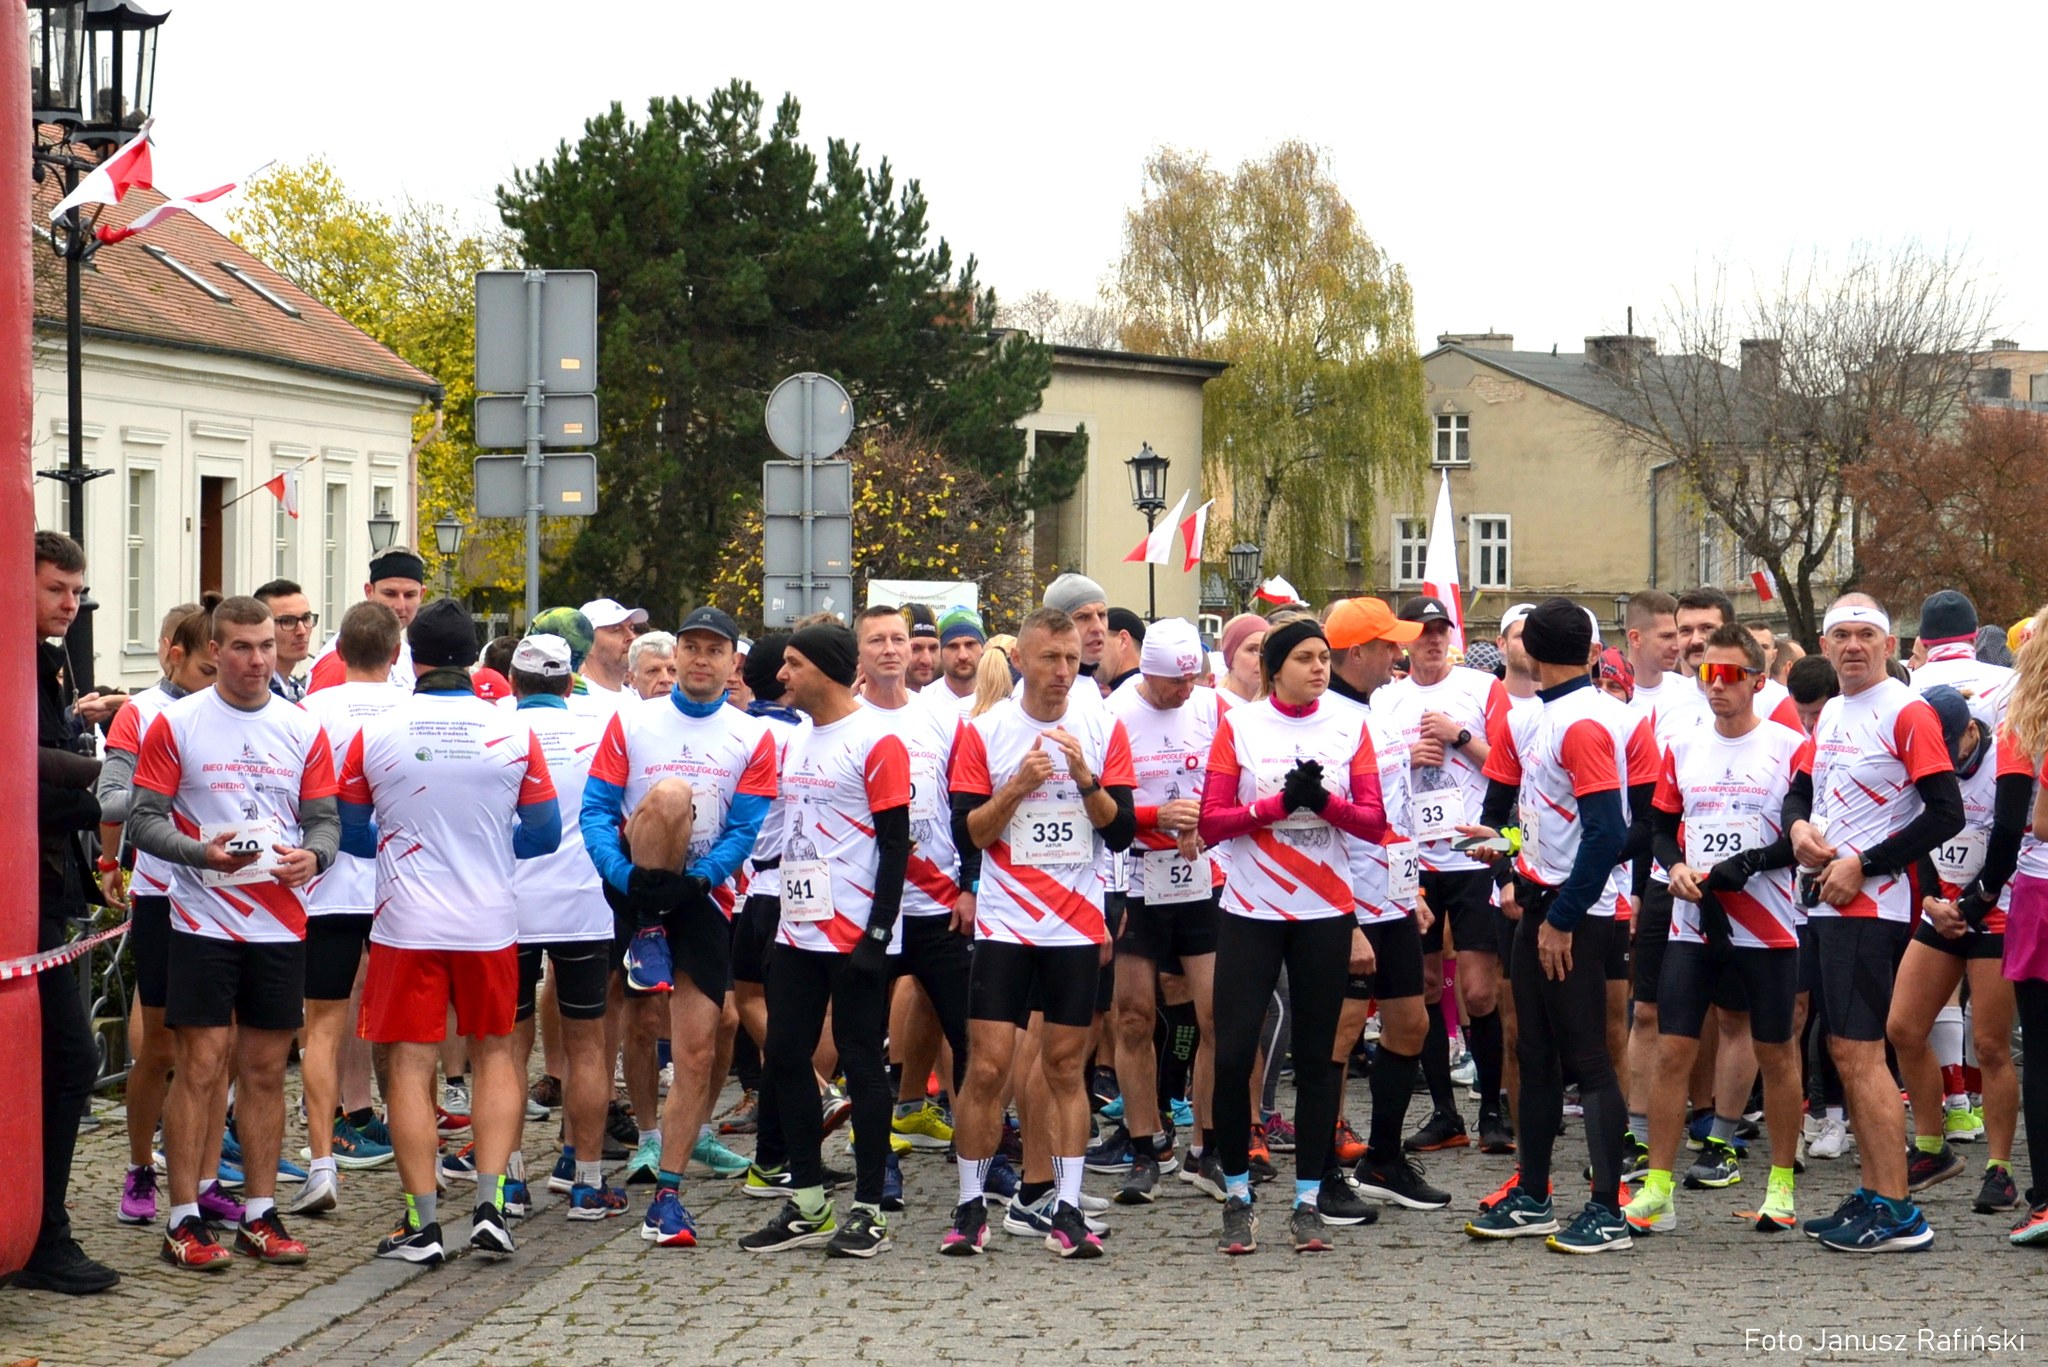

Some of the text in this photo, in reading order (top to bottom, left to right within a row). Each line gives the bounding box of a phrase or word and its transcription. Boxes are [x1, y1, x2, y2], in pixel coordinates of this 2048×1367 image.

[225, 764, 294, 777] NIEPODLEGŁOŚCI
[663, 764, 731, 777] NIEPODLEGŁOŚCI
[210, 782, 245, 790] GNIEZNO
[1422, 805, 1444, 823] 33
[1032, 822, 1073, 843] 335
[1703, 833, 1742, 852] 293
[1938, 846, 1969, 864] 147
[1170, 865, 1193, 884] 52
[786, 879, 815, 900] 541
